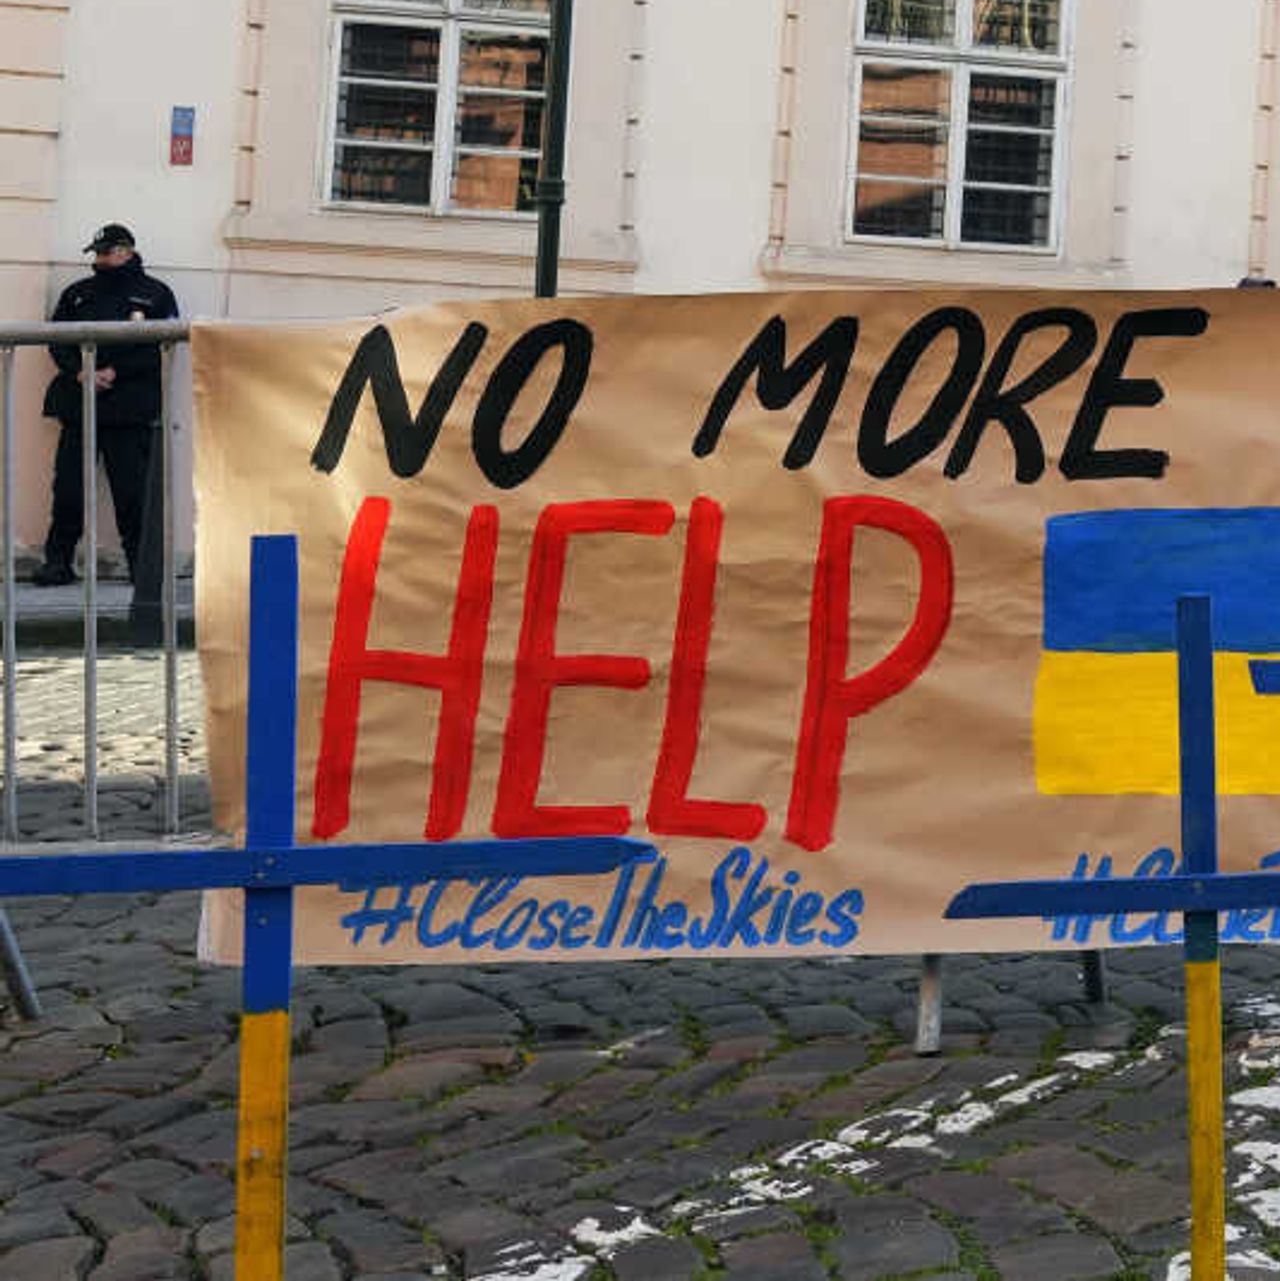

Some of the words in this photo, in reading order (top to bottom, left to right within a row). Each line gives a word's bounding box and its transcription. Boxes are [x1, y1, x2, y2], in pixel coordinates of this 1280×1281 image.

[310, 318, 594, 489] NO
[691, 306, 1210, 484] MORE
[310, 495, 954, 852] HELP
[339, 846, 865, 951] #CloseTheSkies
